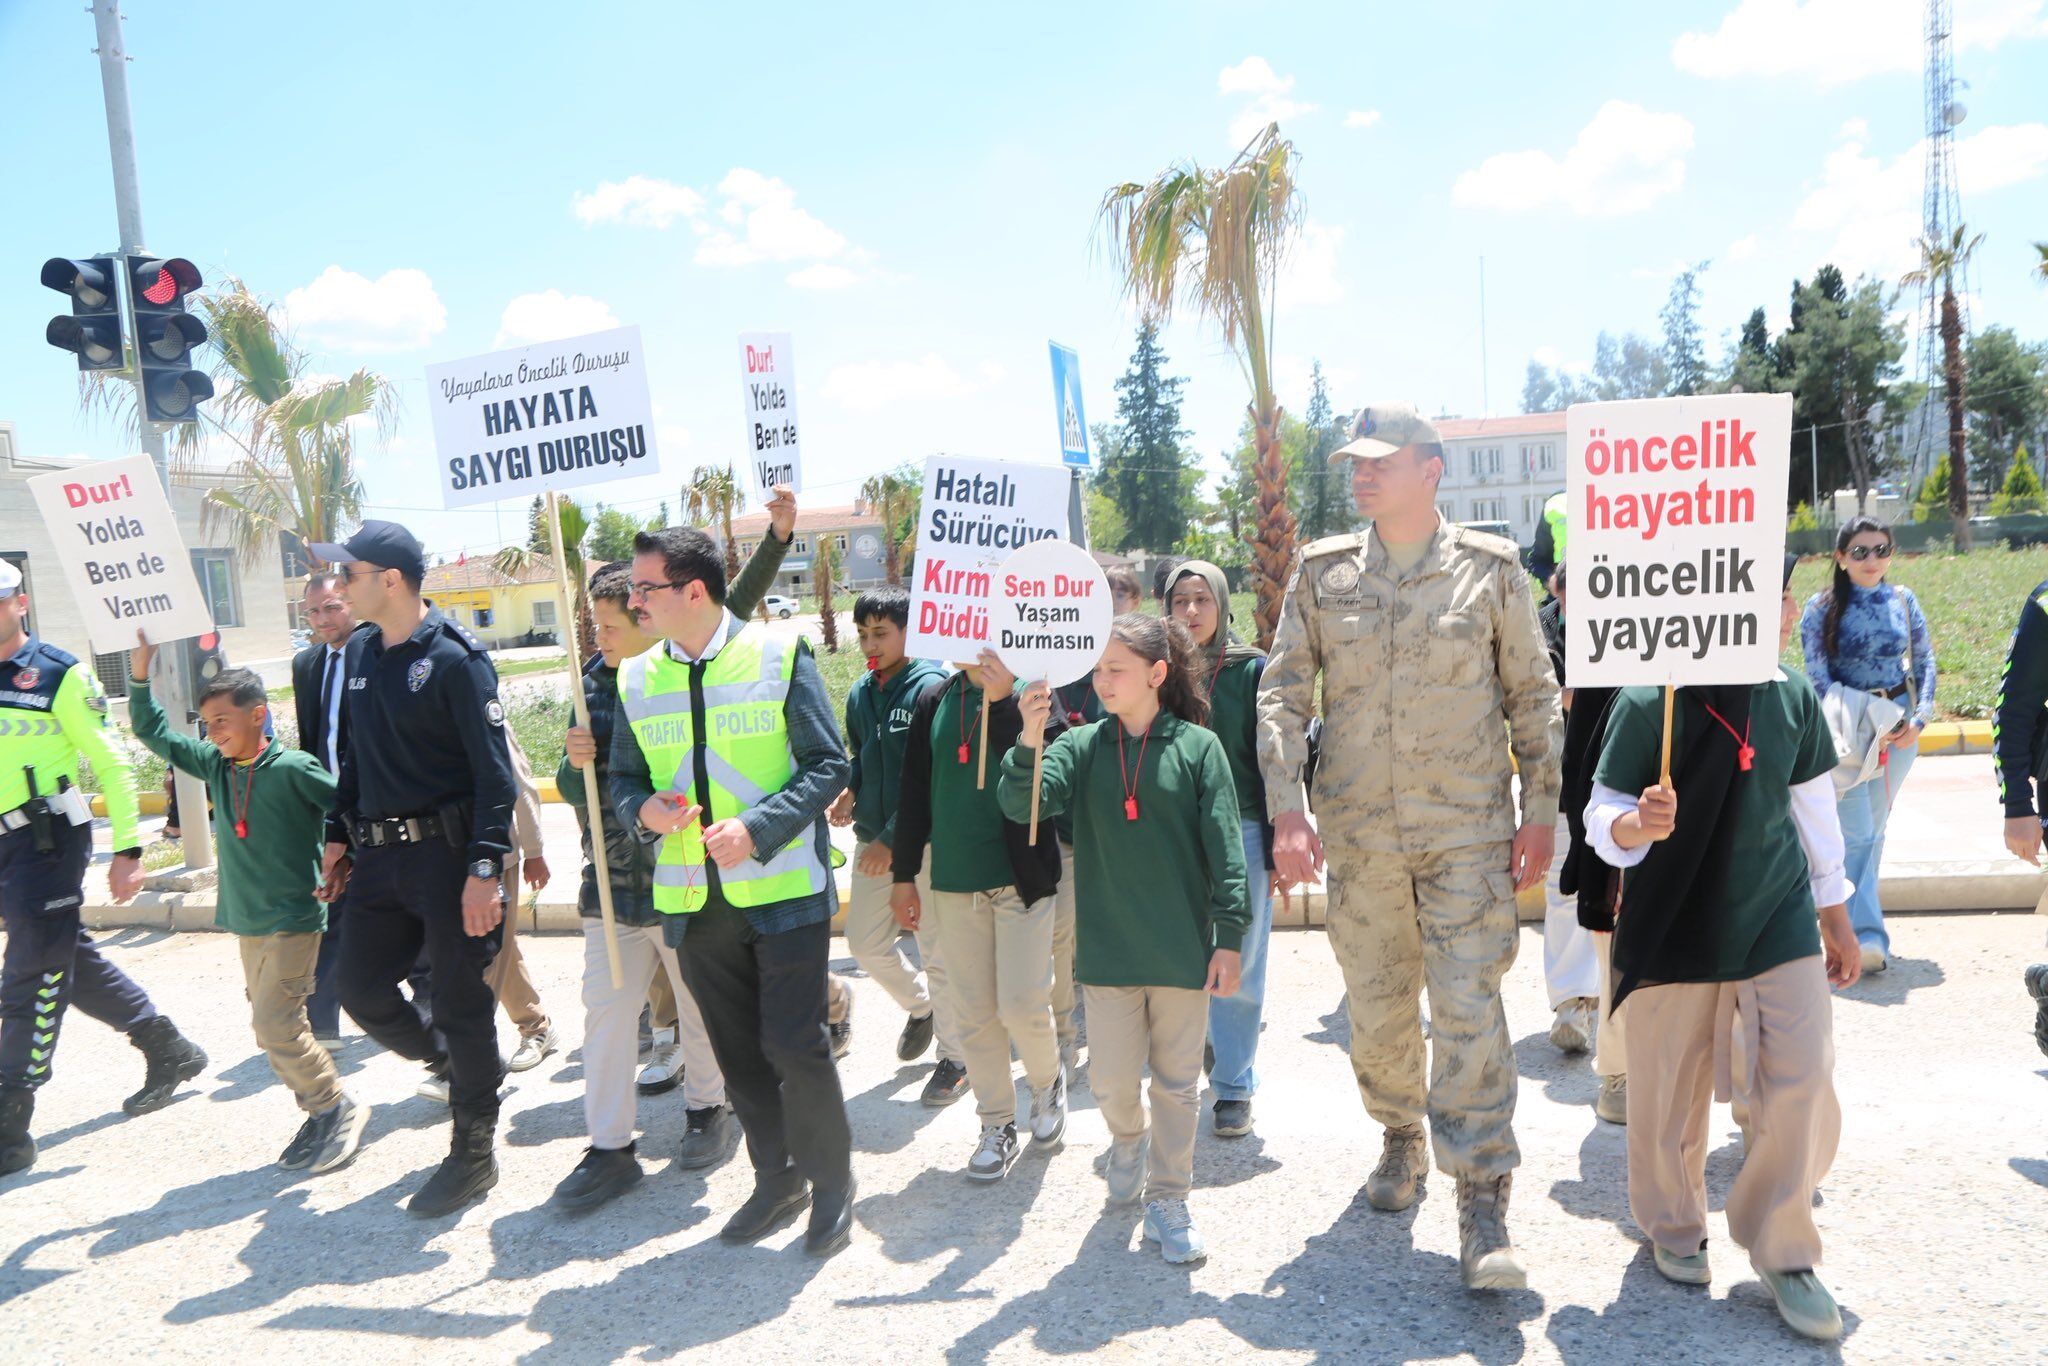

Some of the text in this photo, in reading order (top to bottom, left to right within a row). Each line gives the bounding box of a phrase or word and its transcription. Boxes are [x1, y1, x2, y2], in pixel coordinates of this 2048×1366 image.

[746, 344, 774, 373] Dur!
[441, 350, 630, 403] Yayalara Öncelik Duruşu
[482, 385, 598, 437] HAYATA
[750, 382, 786, 411] Yolda
[755, 418, 797, 450] Ben de
[1585, 419, 1756, 476] öncelik
[449, 424, 646, 490] SAYGI DURUŞU
[63, 474, 133, 508] Dur!
[758, 461, 793, 488] Varım
[935, 468, 1015, 507] Hatalı
[1586, 477, 1755, 540] hayatın
[77, 515, 144, 545] Yolda
[85, 552, 165, 585] Ben de
[1588, 547, 1755, 599] öncelik
[1005, 575, 1094, 597] Sen Dur
[104, 593, 172, 619] Varım
[1015, 603, 1079, 628] Yaşam
[1001, 630, 1095, 650] Durmasın
[1588, 611, 1758, 663] yayayın
